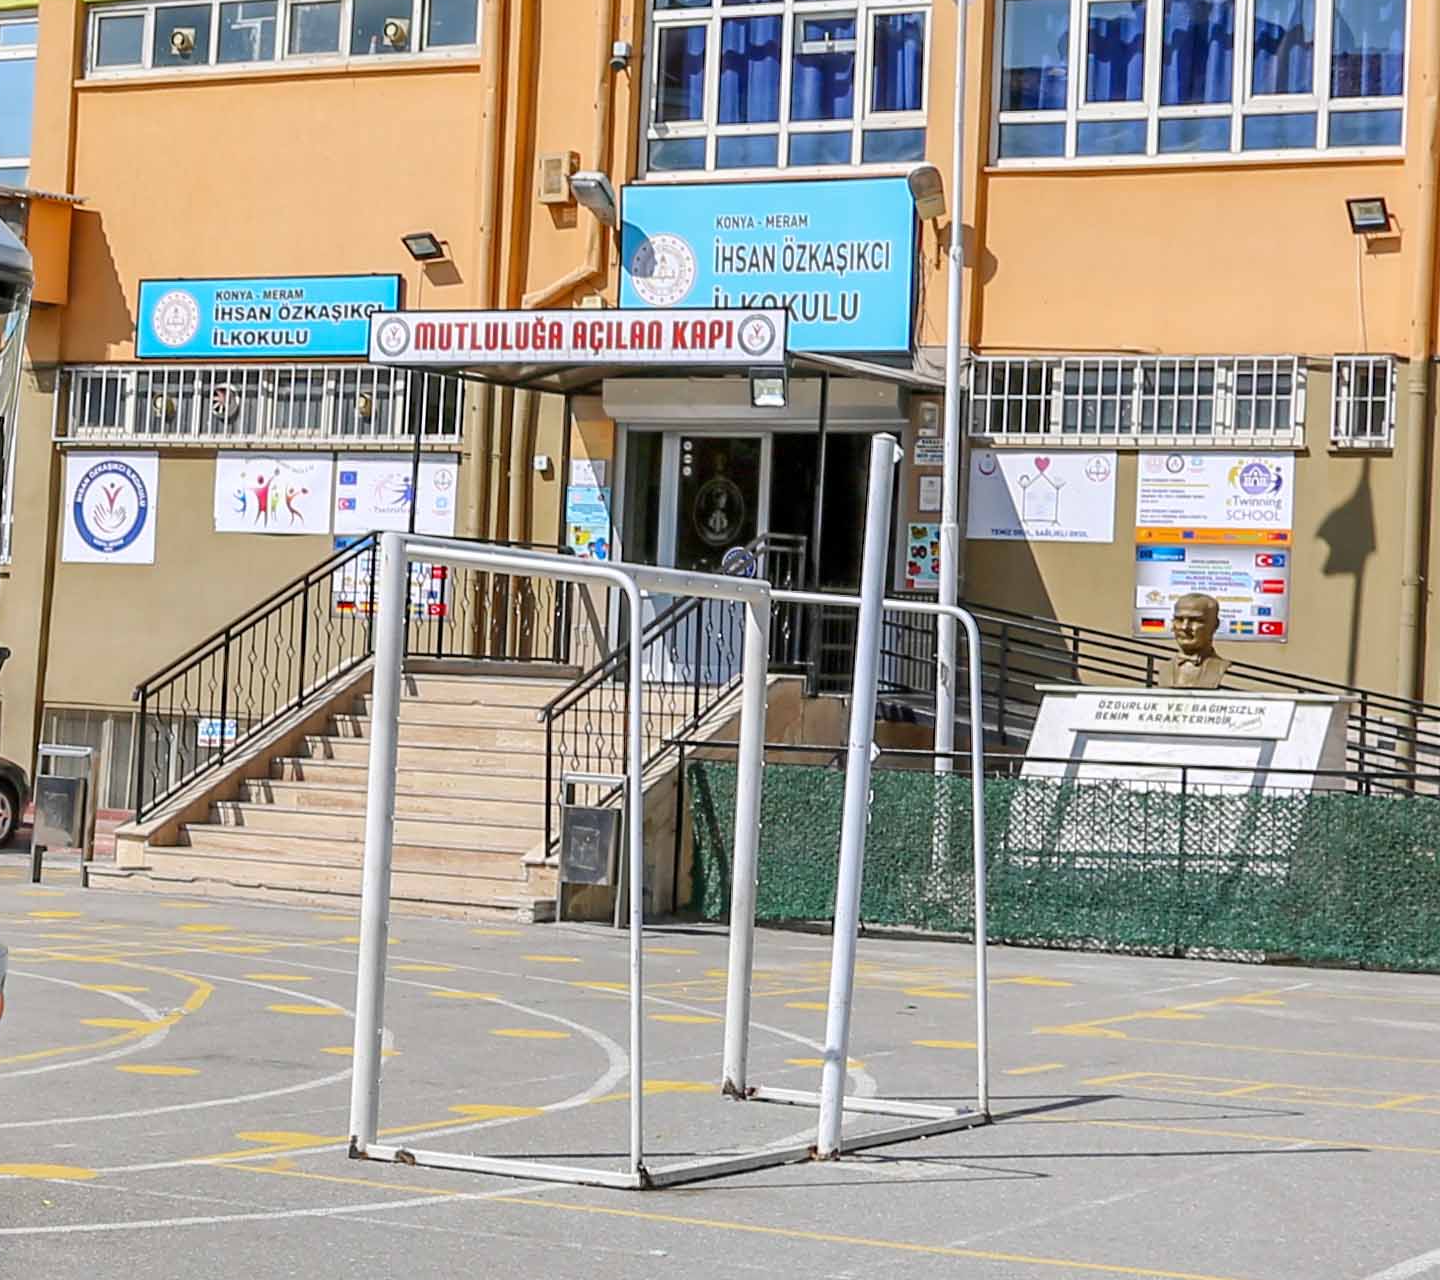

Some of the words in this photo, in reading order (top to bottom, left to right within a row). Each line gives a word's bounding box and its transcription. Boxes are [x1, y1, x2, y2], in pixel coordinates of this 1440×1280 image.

[716, 216, 754, 229] KONYA
[766, 215, 808, 228] MERAM
[714, 239, 775, 273] İHSAN
[782, 237, 890, 278] ÖZKAŞIKCI
[216, 290, 253, 301] KONYA
[263, 289, 303, 300] MERAM
[215, 304, 270, 322] İHSAN
[213, 328, 308, 346] İLKOKULU
[414, 316, 562, 351] MUTLULUĞA
[572, 320, 662, 356] AÇILAN
[673, 320, 733, 348] KAPI
[1227, 510, 1281, 521] SCHOOL
[1168, 703, 1183, 712] VE
